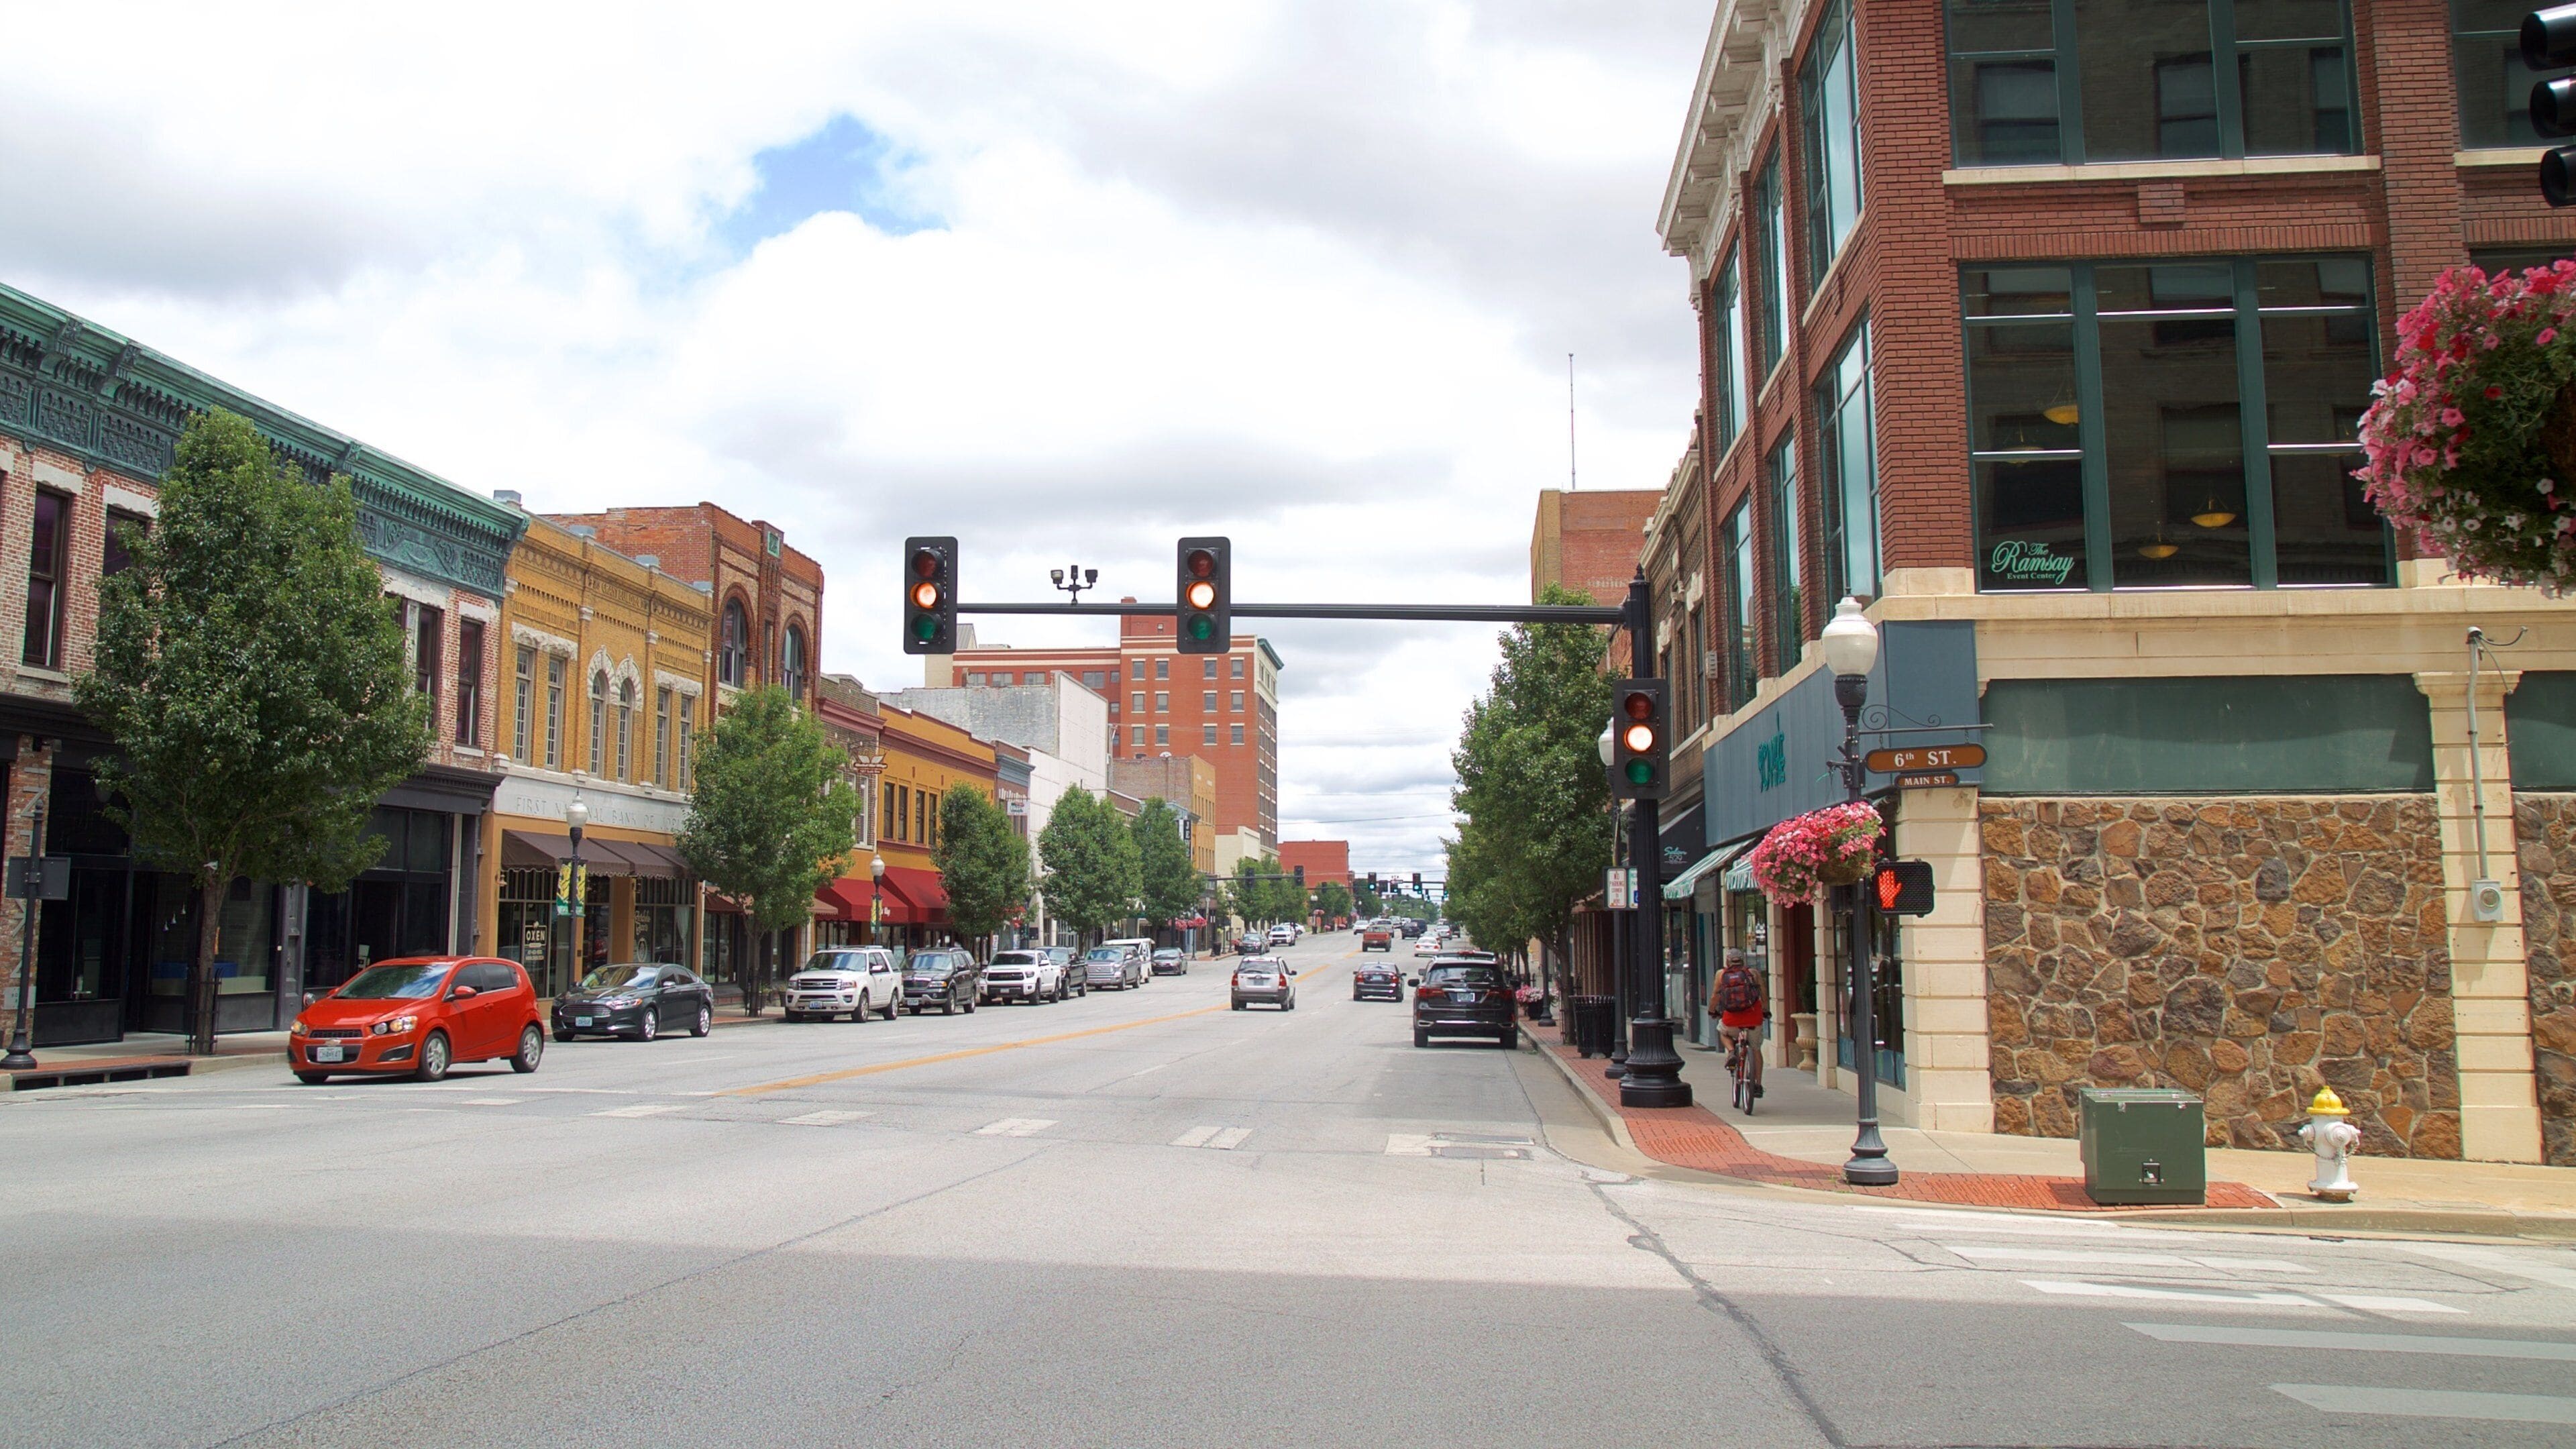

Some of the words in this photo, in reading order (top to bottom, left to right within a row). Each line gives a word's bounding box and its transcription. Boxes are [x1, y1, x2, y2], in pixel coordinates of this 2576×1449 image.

[2028, 542, 2049, 555] The
[1991, 541, 2075, 585] Ramsay
[1894, 753, 1915, 767] 6th
[1927, 750, 1957, 765] ST.
[1904, 777, 1929, 786] MAIN
[1934, 775, 1950, 784] ST.
[516, 796, 547, 814] FIRST
[555, 802, 605, 822] NANAL
[612, 809, 637, 826] BANK
[643, 814, 655, 828] OF
[526, 930, 545, 941] OXEN
